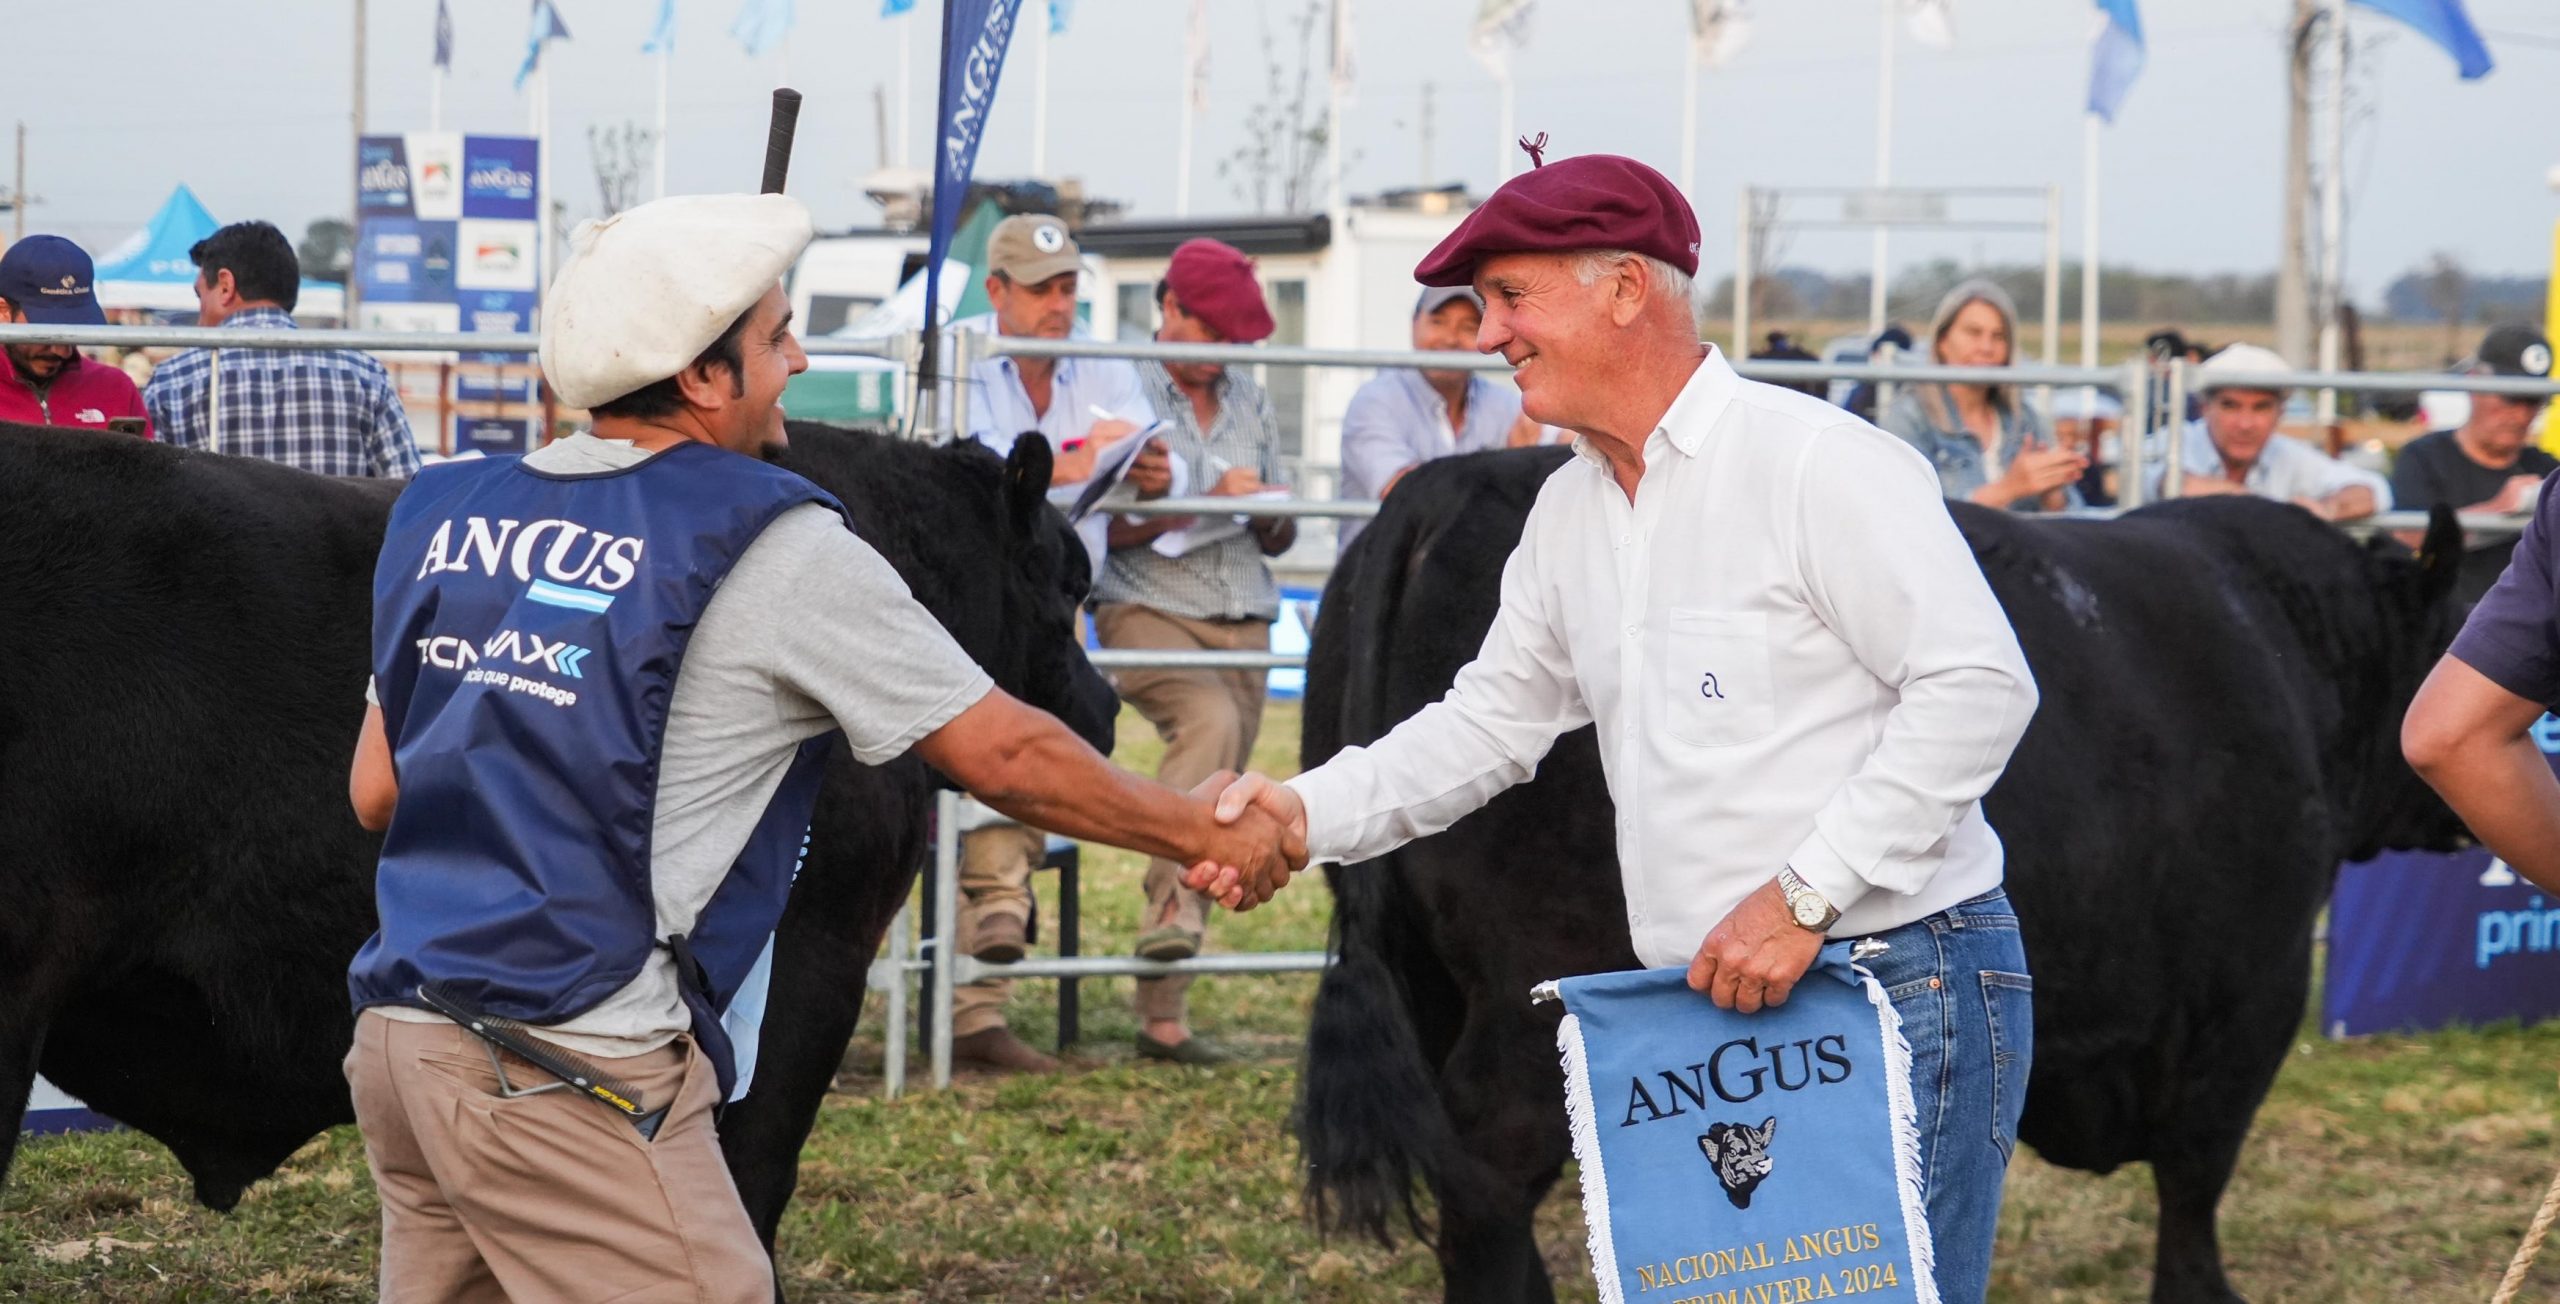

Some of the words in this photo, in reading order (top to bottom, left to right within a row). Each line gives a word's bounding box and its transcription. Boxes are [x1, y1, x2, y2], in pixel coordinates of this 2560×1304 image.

[946, 0, 1004, 172] ANGUS
[483, 670, 508, 685] que
[508, 676, 577, 706] protege
[1620, 1034, 1852, 1127] ANGUS
[1636, 1242, 1774, 1292] NACIONAL
[1782, 1223, 1880, 1264] ANGUS
[1840, 1262, 1898, 1294] 2024
